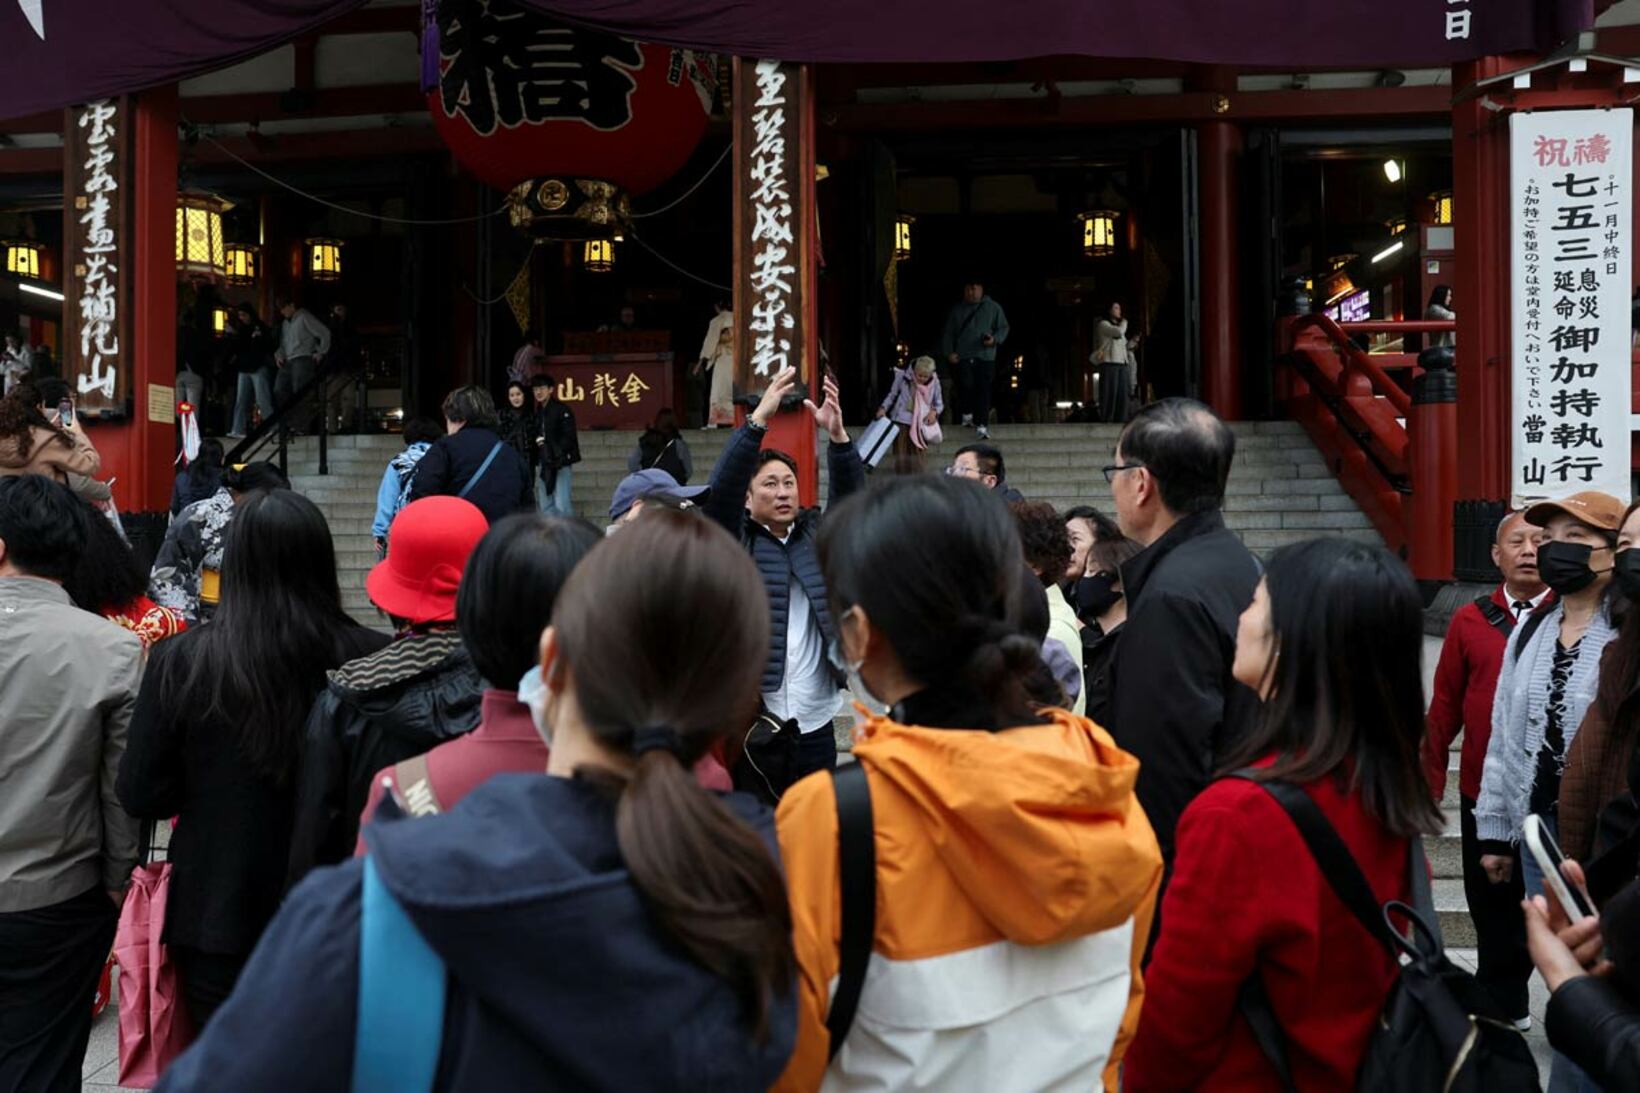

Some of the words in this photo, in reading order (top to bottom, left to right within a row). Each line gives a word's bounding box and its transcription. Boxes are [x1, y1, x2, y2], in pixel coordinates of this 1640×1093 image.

[1445, 0, 1472, 40] 日
[1551, 172, 1601, 262] 七五三
[1552, 270, 1577, 321] 延命
[1577, 267, 1601, 320] 息災
[1547, 324, 1604, 483] 御加持執行
